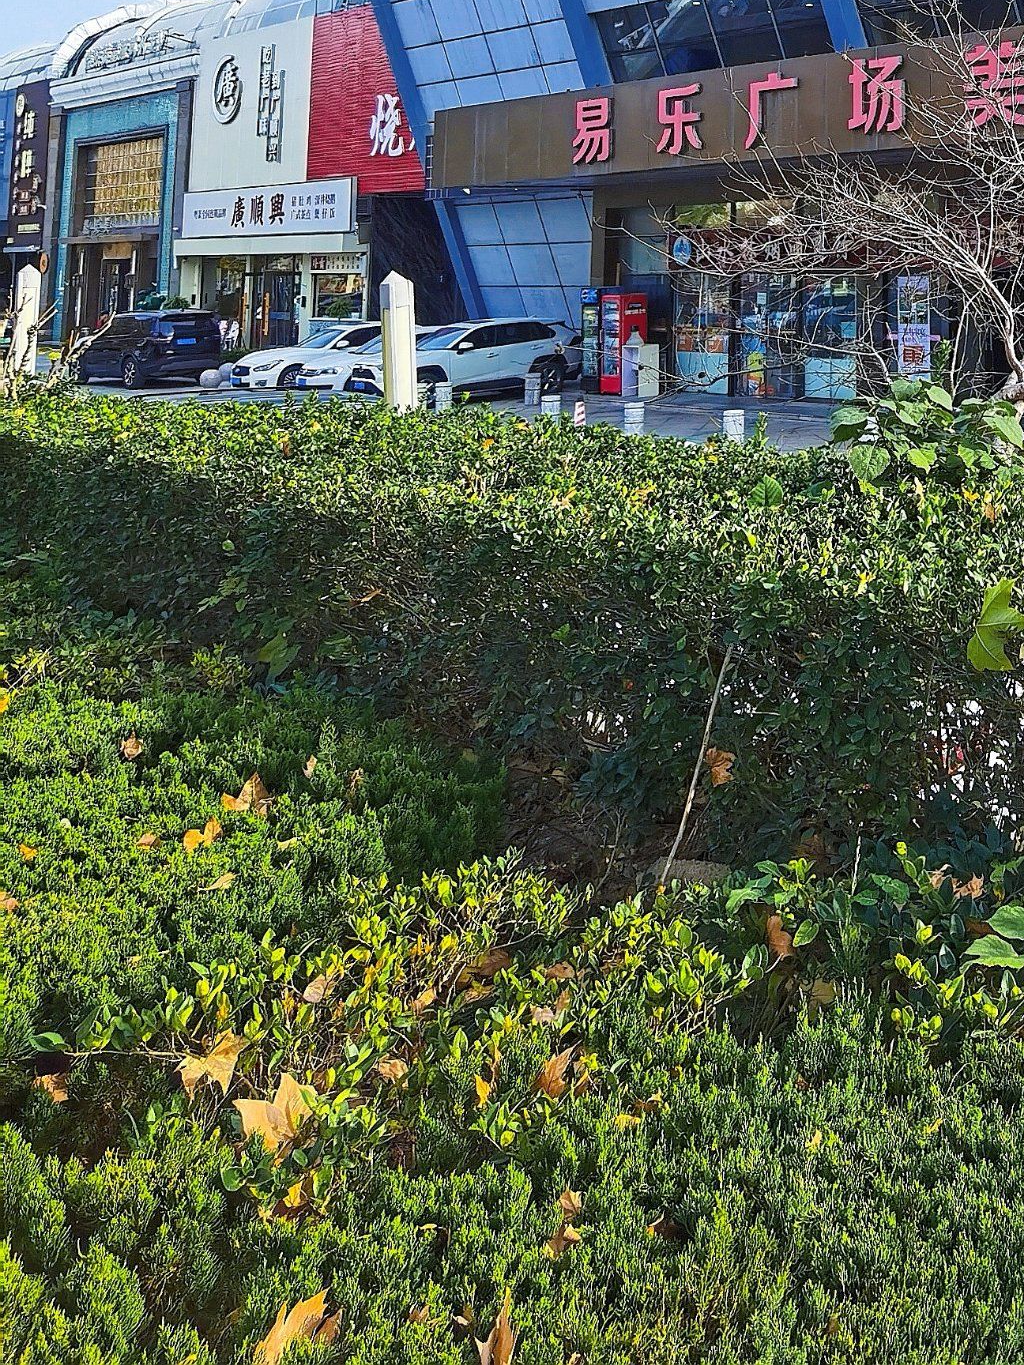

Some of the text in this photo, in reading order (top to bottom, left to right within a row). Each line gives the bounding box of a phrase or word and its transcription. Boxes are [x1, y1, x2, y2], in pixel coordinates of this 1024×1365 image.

[369, 93, 415, 156] 烧
[230, 193, 286, 228] 廣順興
